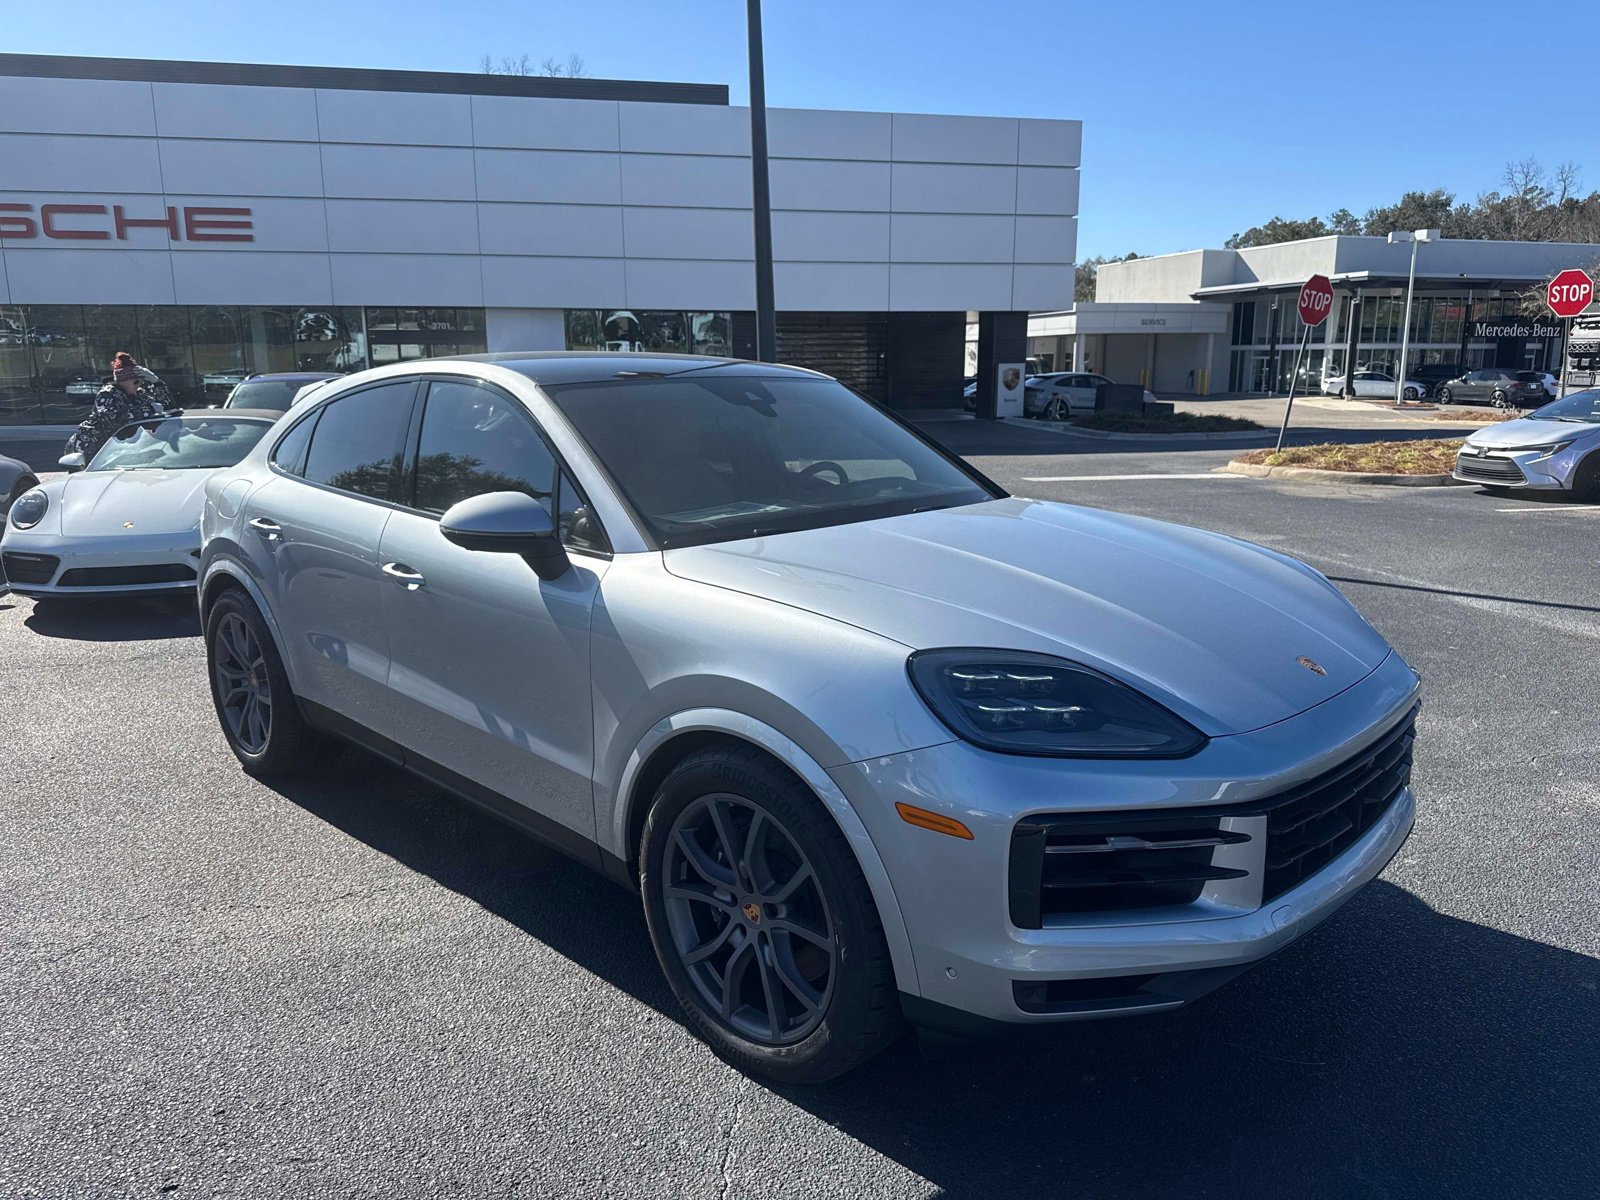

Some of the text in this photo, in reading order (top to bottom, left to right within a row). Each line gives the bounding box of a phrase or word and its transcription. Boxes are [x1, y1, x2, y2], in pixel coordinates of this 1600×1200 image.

[1300, 289, 1331, 311] STOP
[1550, 284, 1590, 303] STOP
[432, 322, 450, 330] 3701
[1141, 318, 1167, 326] SERVICE
[1474, 322, 1560, 337] Mercedes-Benz
